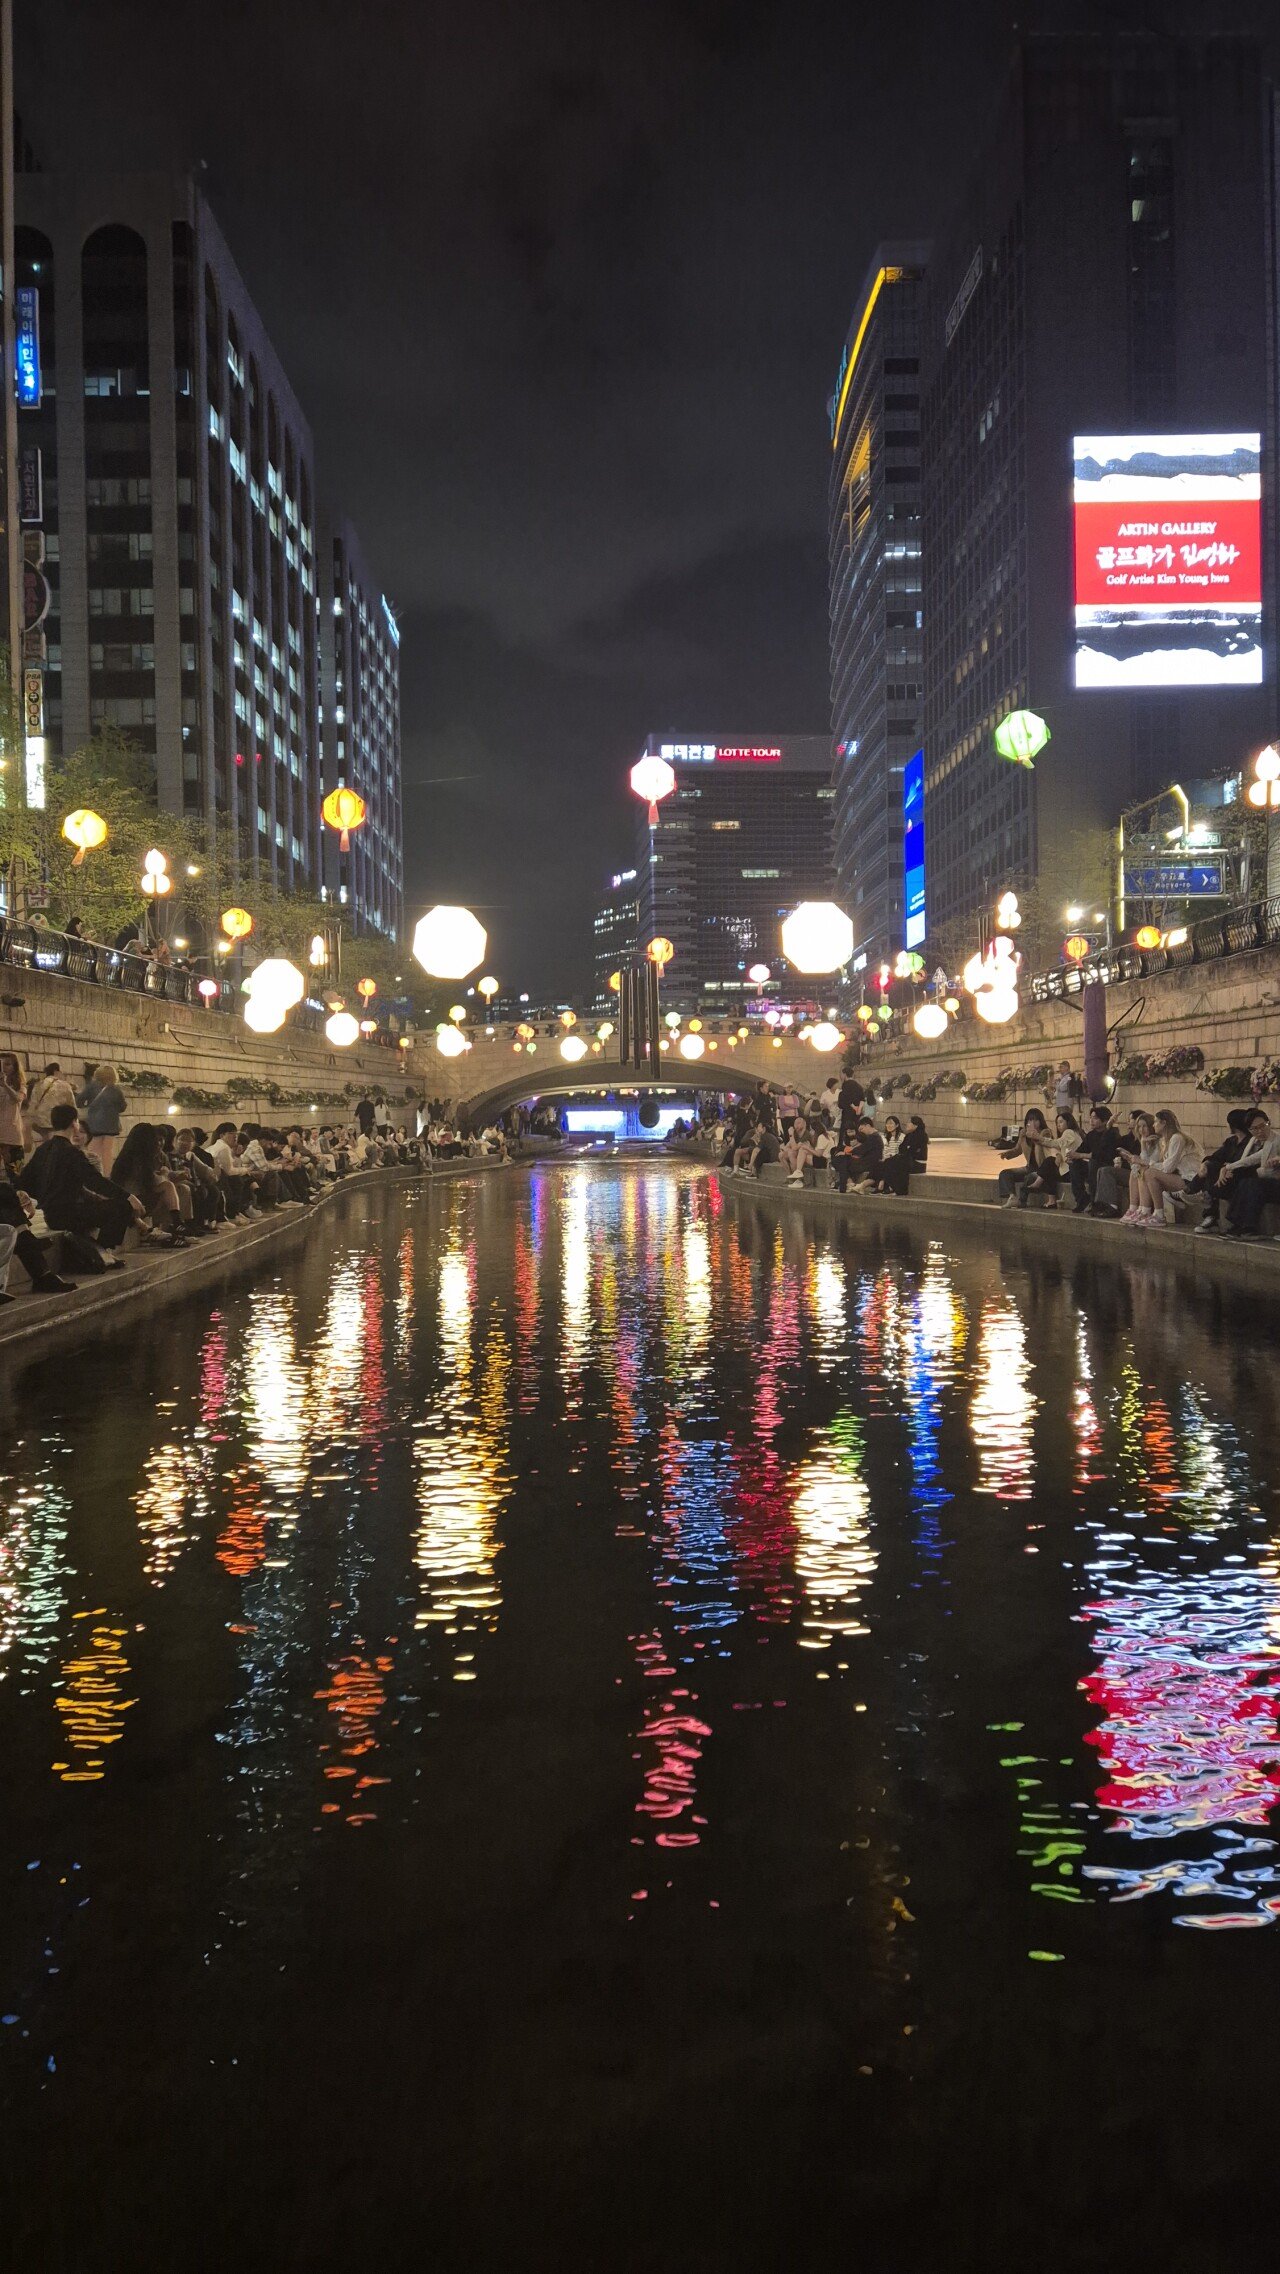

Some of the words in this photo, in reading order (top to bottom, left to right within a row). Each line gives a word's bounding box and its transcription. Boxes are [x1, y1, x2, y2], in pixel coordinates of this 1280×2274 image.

[21, 292, 35, 389] 미래이비인후과
[1118, 523, 1159, 536] ARTIN
[1161, 522, 1217, 536] GALLERY
[1095, 544, 1176, 569] 골프화가
[1106, 573, 1128, 585] Golf
[1129, 573, 1155, 585] Artist
[1156, 573, 1177, 585] Kim
[1178, 573, 1209, 586] Young
[1210, 573, 1230, 584] hwa
[661, 745, 716, 760] 롯데관광
[718, 748, 751, 757] LOTTE
[751, 748, 781, 757] TOUR
